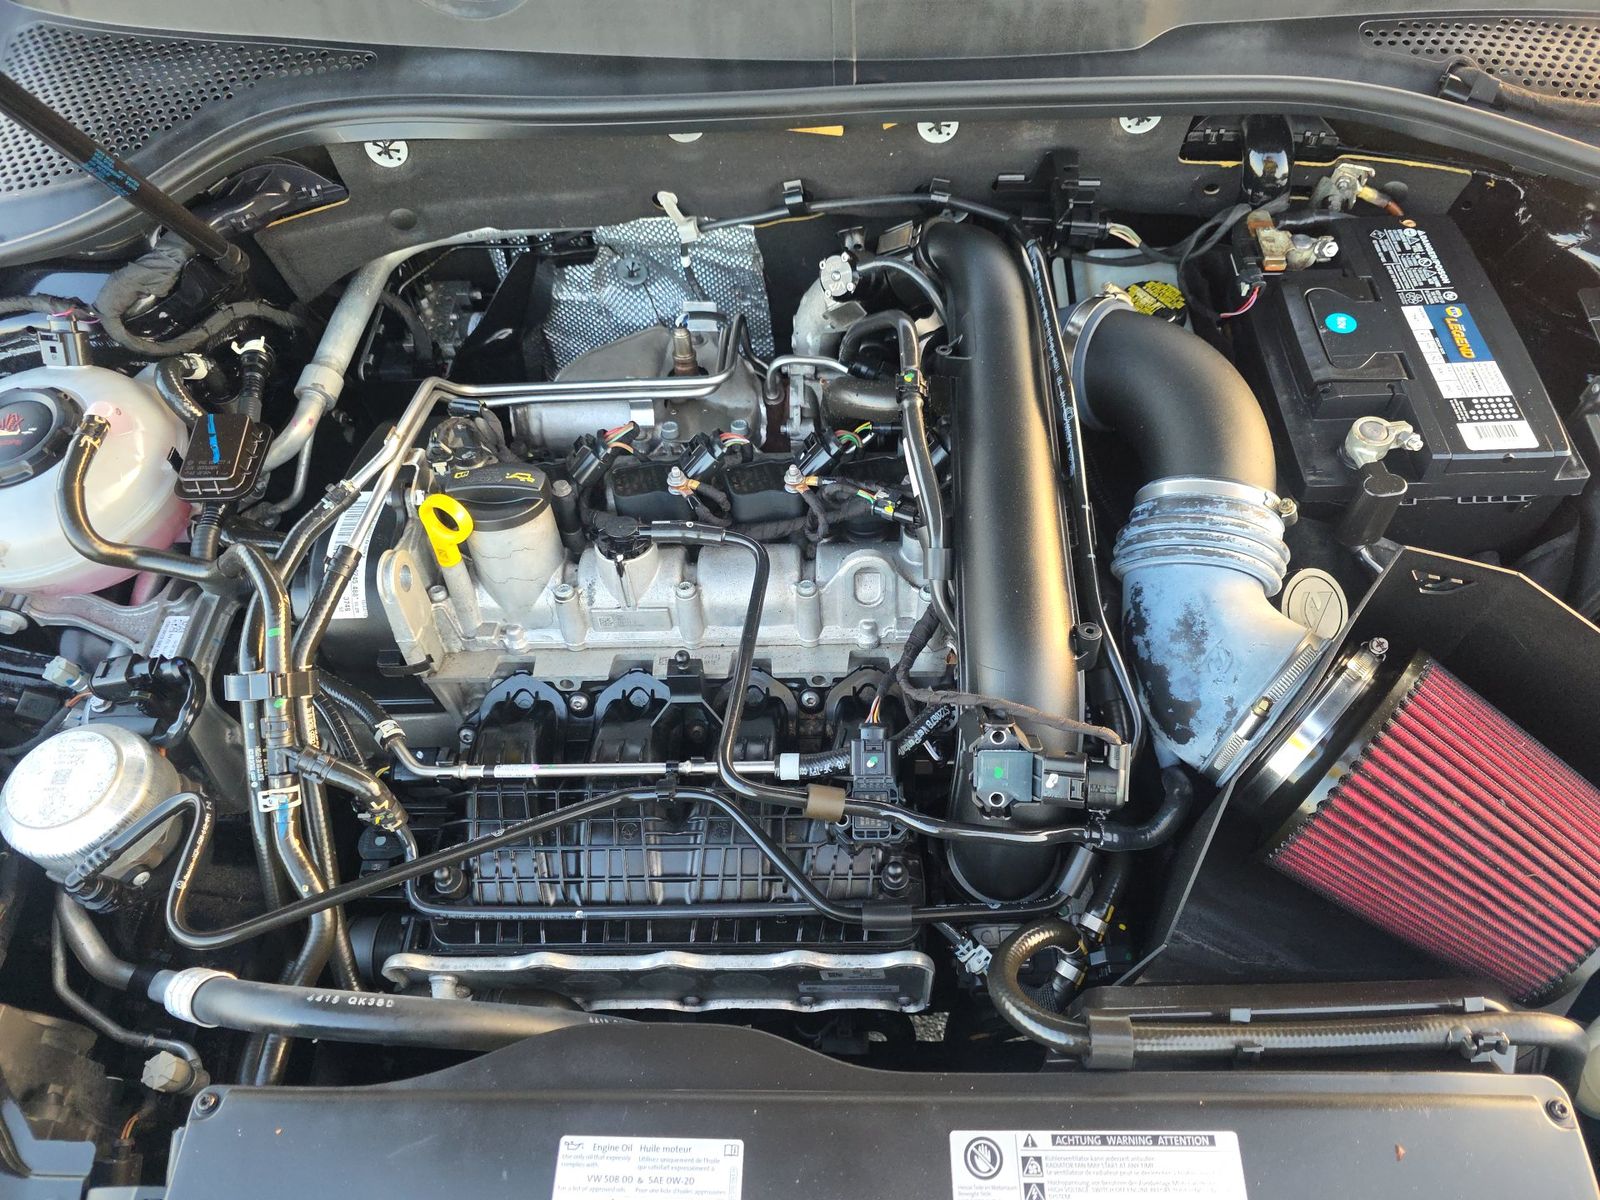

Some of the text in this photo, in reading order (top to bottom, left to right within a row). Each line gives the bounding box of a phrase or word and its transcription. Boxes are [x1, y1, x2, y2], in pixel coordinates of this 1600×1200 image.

[1055, 1135, 1210, 1146] ACHTUNG WARNING ATTENTION
[592, 1143, 633, 1153] Engine Oil
[639, 1144, 692, 1153] Huile moteur
[586, 1175, 603, 1183] VW
[604, 1175, 620, 1183] 508
[637, 1176, 644, 1184] &
[648, 1176, 664, 1184] SAE
[666, 1176, 695, 1185] 0W-20
